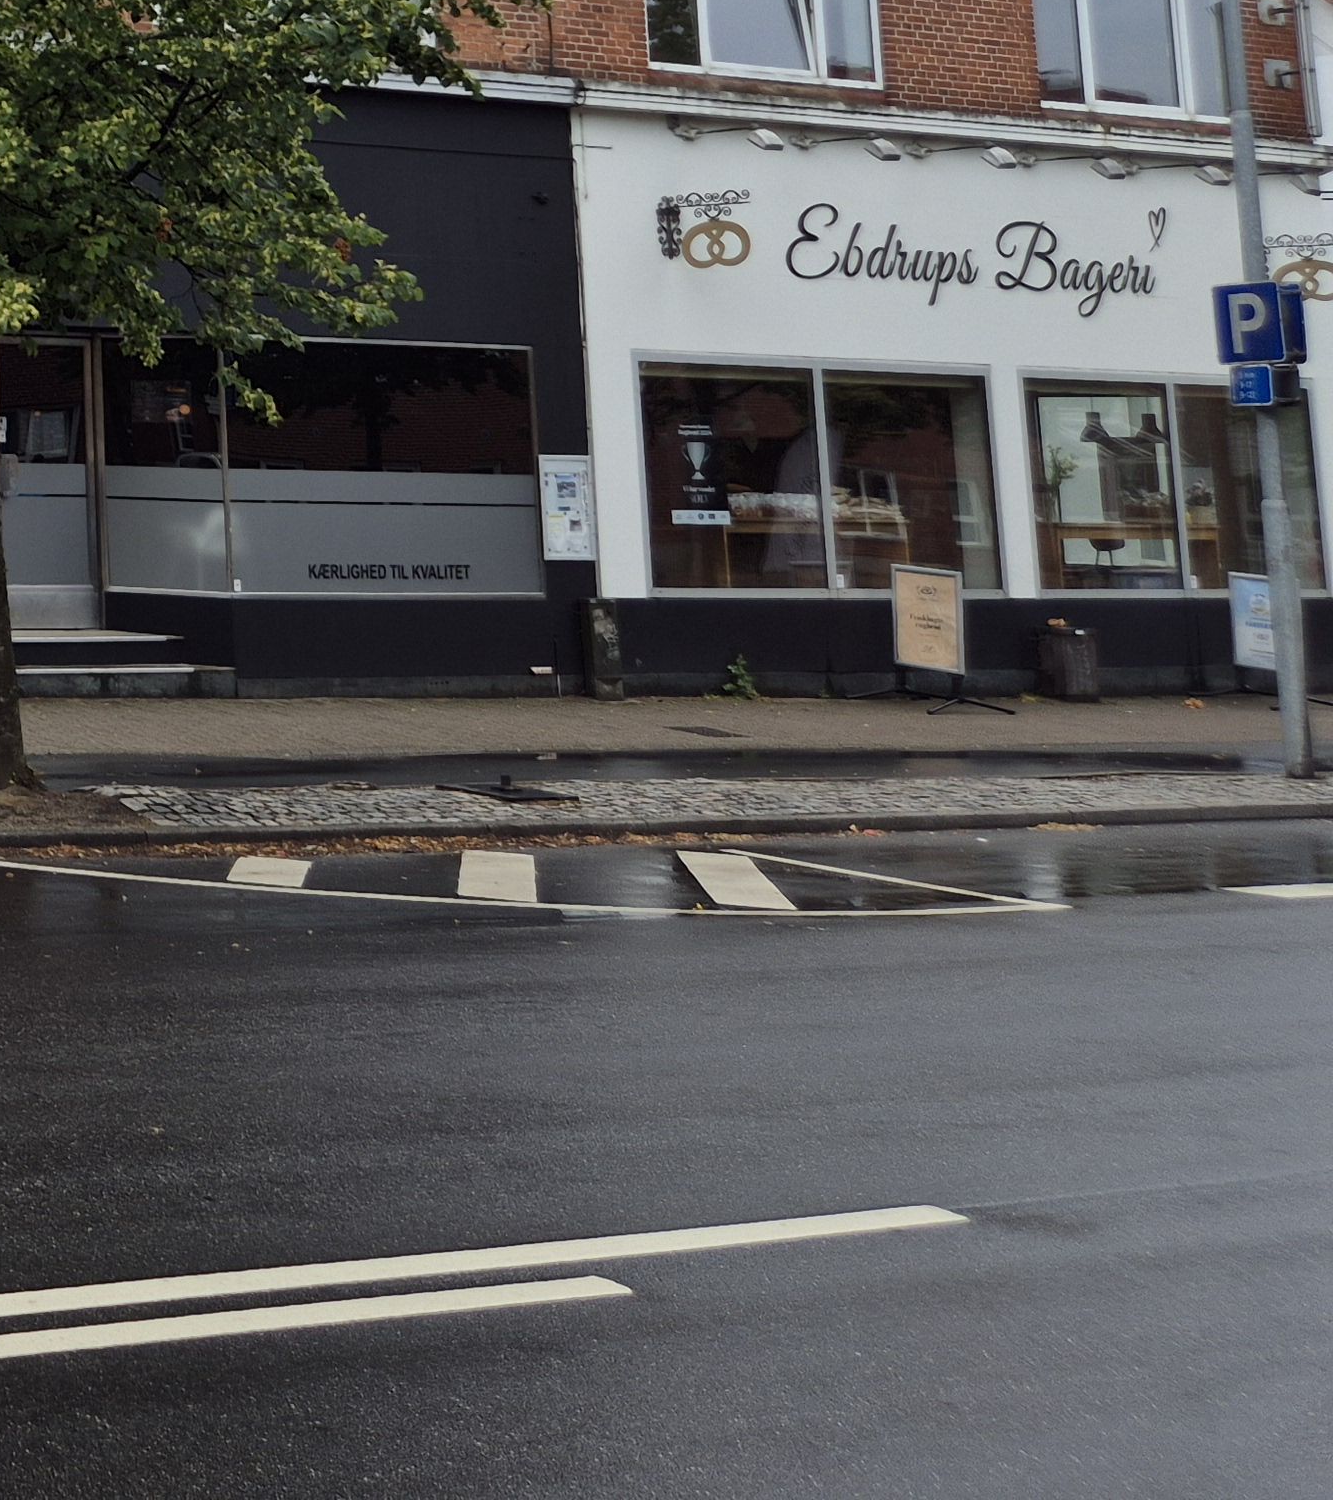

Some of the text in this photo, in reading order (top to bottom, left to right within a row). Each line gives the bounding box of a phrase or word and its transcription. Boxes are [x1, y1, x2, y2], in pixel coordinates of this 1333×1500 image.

[785, 202, 1157, 318] Ebdrups Bageri
[1227, 292, 1266, 354] P
[308, 563, 471, 580] KÆRLIGHED TIL KVALITET
